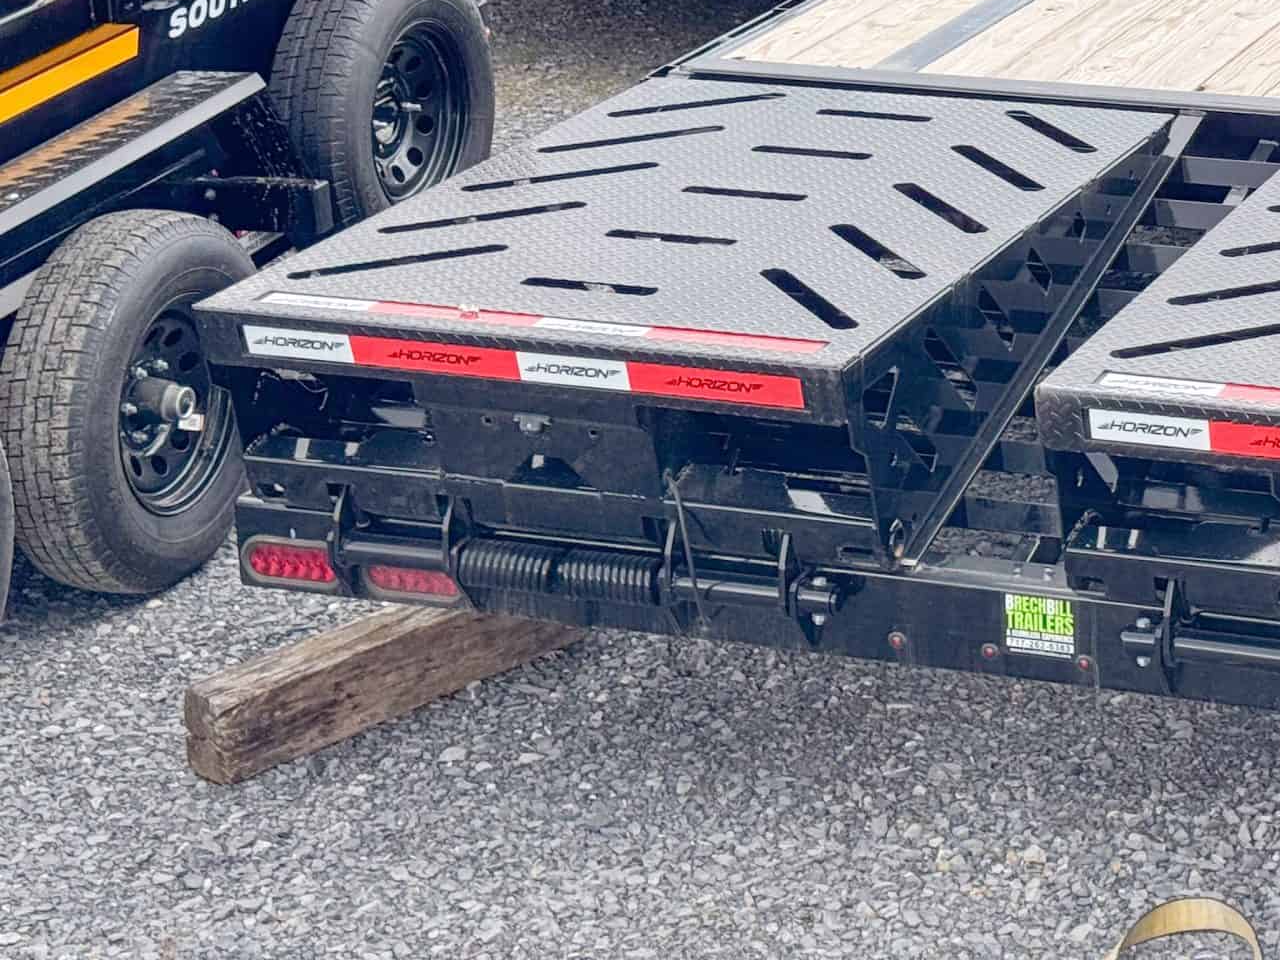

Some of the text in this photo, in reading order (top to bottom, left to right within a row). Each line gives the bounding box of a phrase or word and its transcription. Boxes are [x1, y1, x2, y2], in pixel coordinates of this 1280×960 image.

[263, 335, 335, 351] HORIZON
[398, 349, 471, 367] HORIZON
[535, 361, 610, 380] HORIZON
[676, 375, 753, 394] HORIZON
[1109, 419, 1193, 439] HORIZON
[1005, 593, 1073, 617] BRECHBILL
[1007, 611, 1075, 636] TRAILERS
